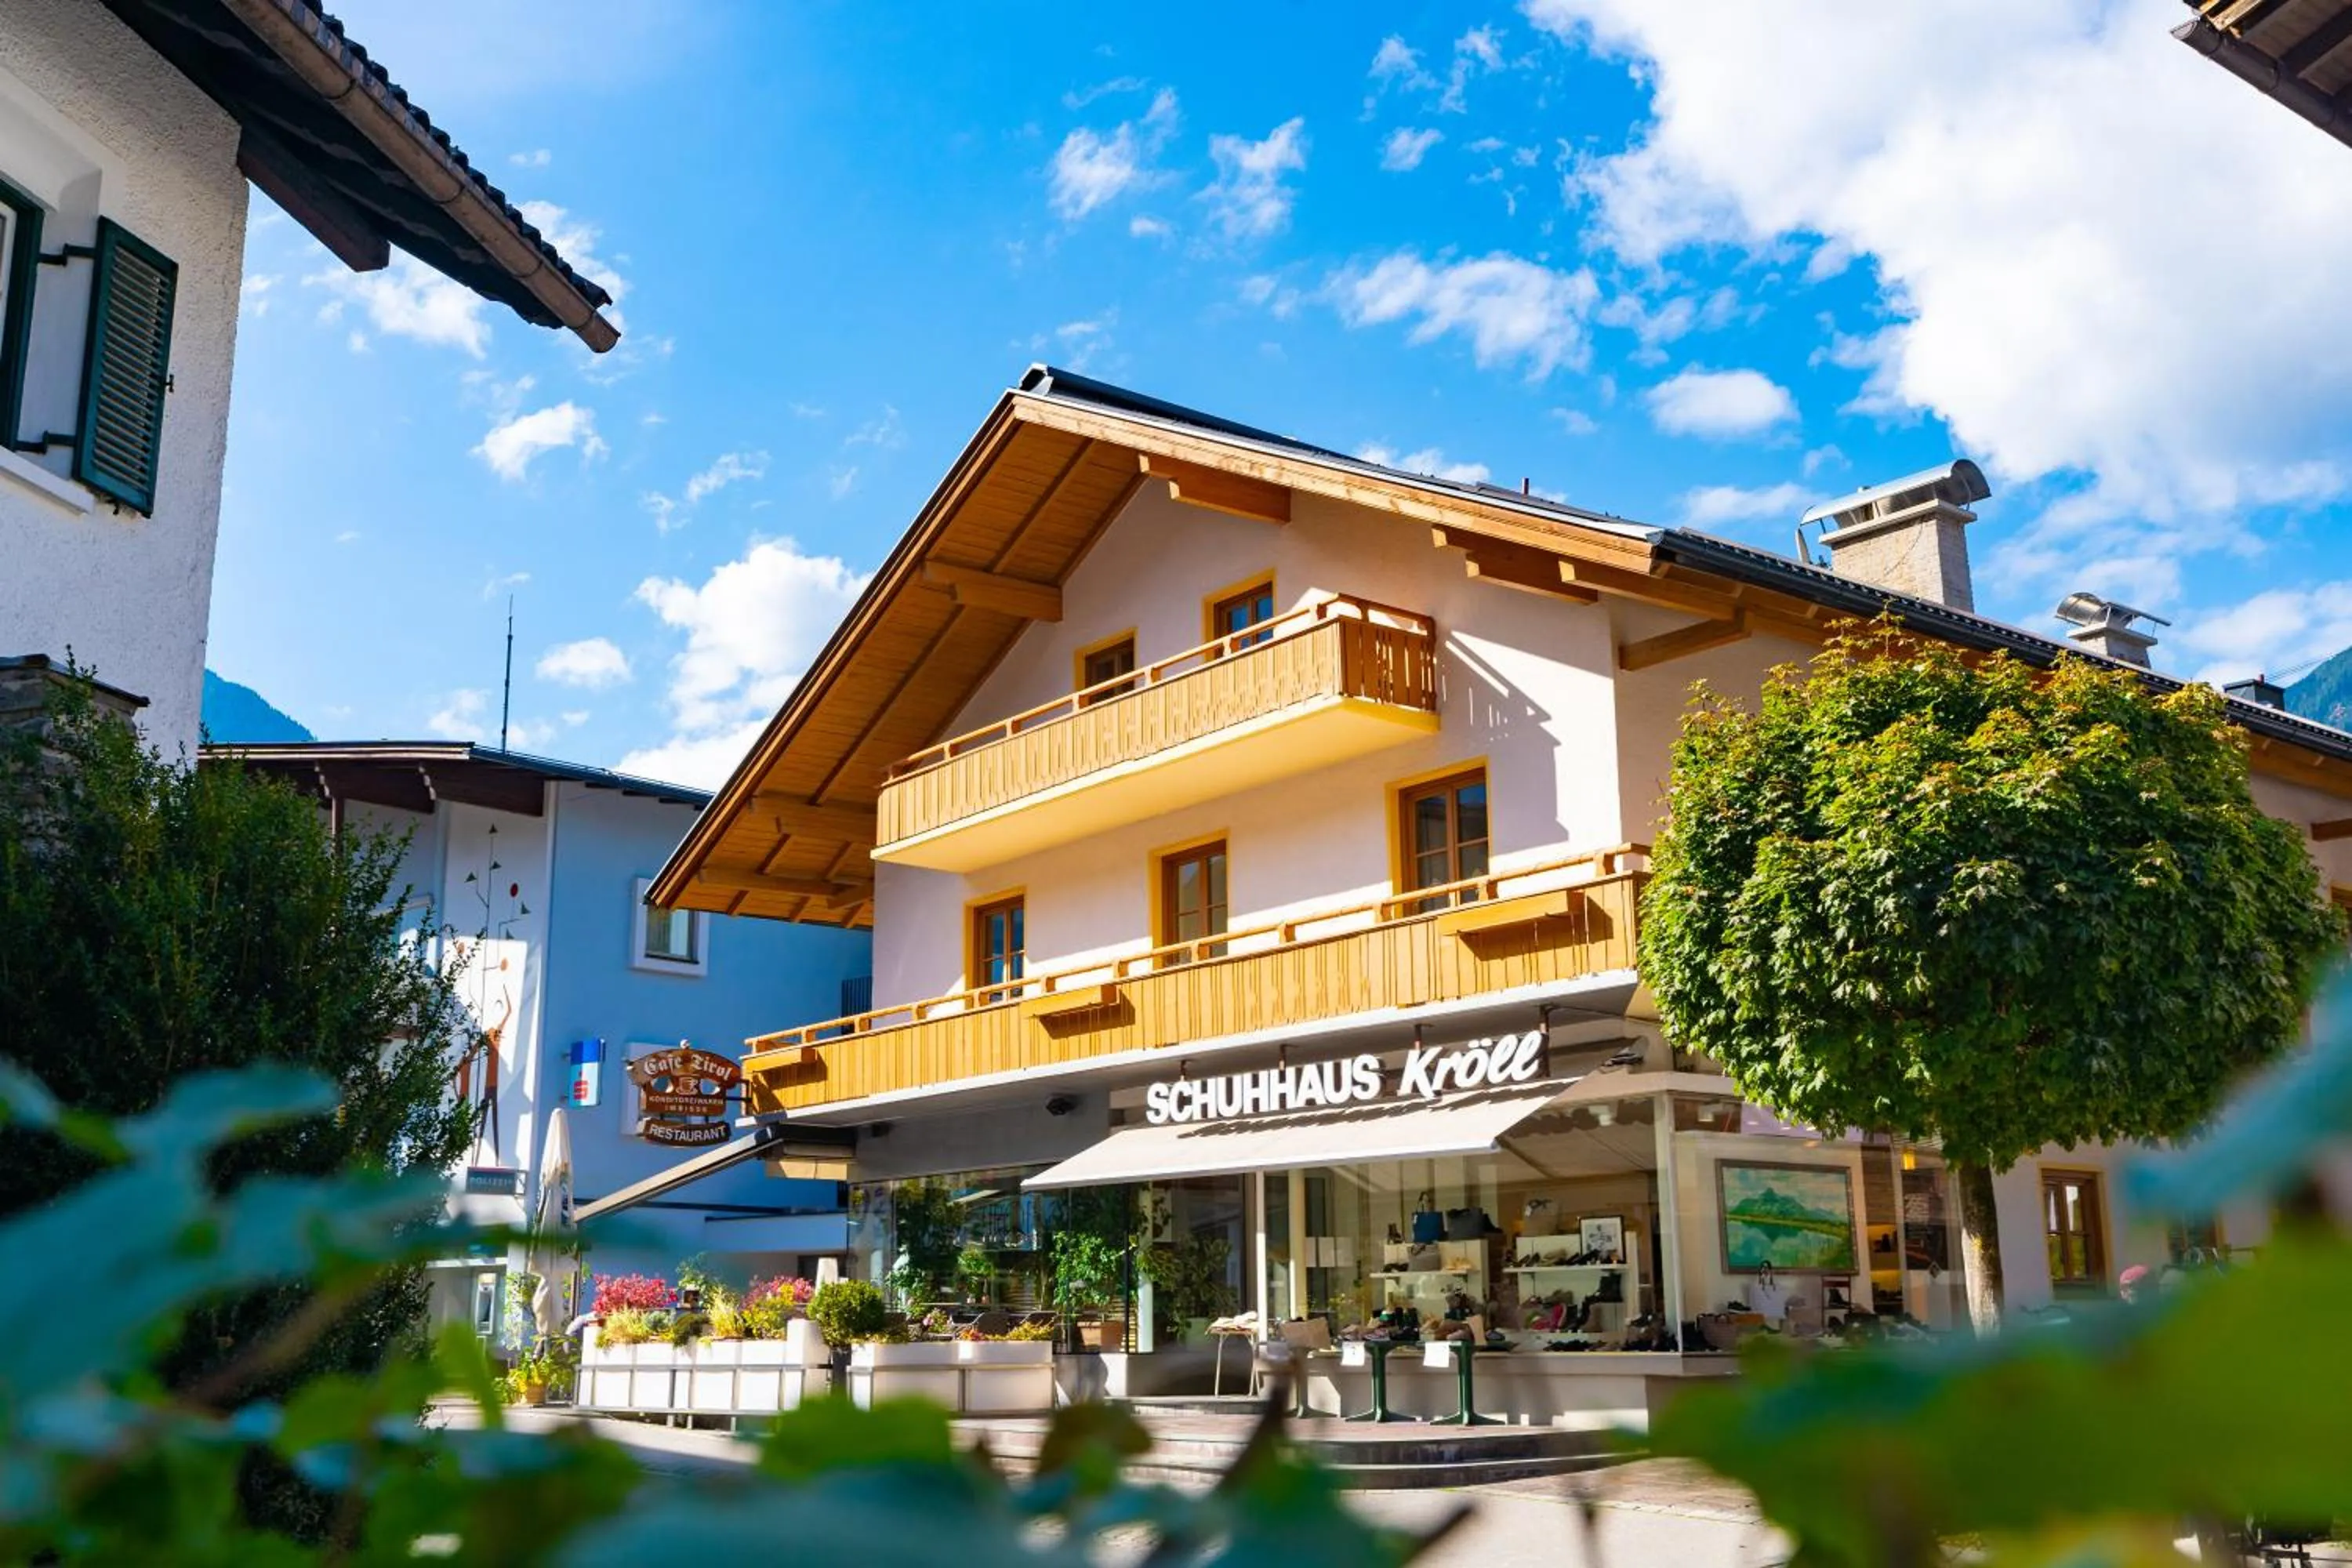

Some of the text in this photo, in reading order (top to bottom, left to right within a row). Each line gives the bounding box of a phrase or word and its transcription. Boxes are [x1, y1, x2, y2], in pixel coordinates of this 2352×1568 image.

[691, 1053, 733, 1080] Tirol
[1146, 1029, 1542, 1123] SCHUHHAUS Kröll
[649, 1123, 726, 1142] RESTAURANT
